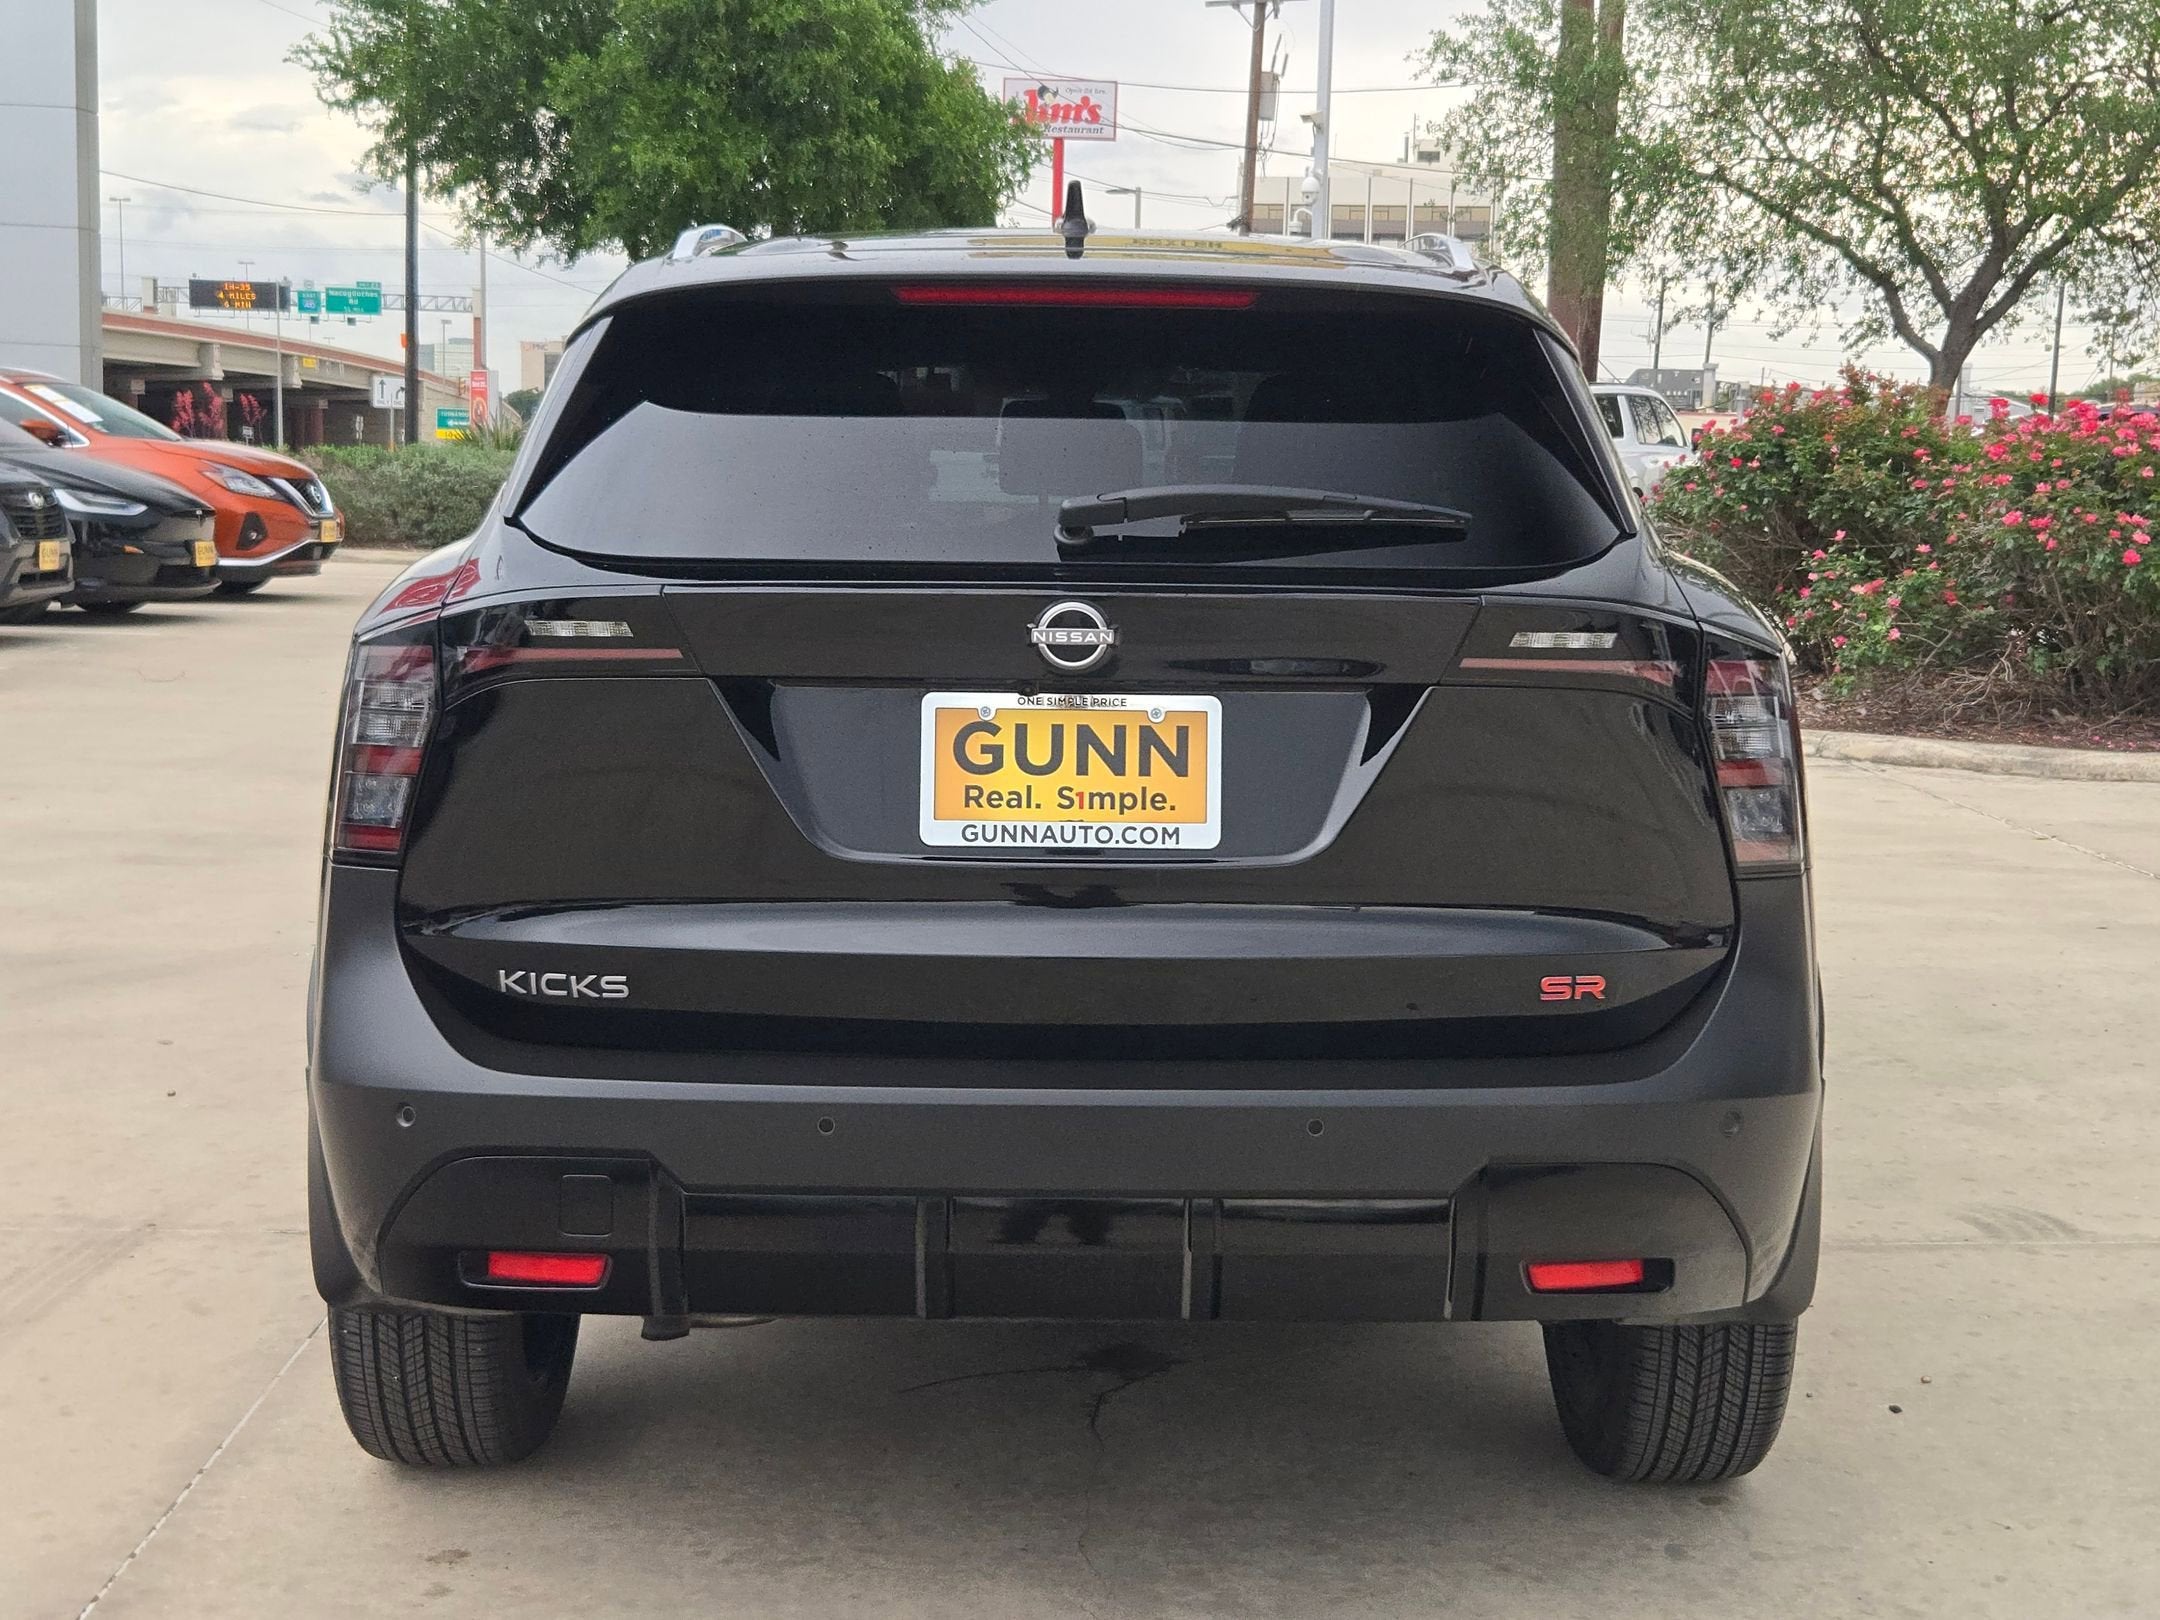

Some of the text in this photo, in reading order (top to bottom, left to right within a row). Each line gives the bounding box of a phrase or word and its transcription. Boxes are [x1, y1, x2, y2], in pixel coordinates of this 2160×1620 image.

[229, 292, 257, 300] MILES
[1032, 630, 1114, 643] NISSAN
[1017, 696, 1127, 708] ONE SIMPLE PRICE
[953, 720, 1190, 778] GUNN
[964, 784, 1042, 810] Real.
[961, 824, 1181, 846] GUNNAUTO.COM
[498, 969, 630, 998] KICKS
[1540, 975, 1607, 1001] SR
